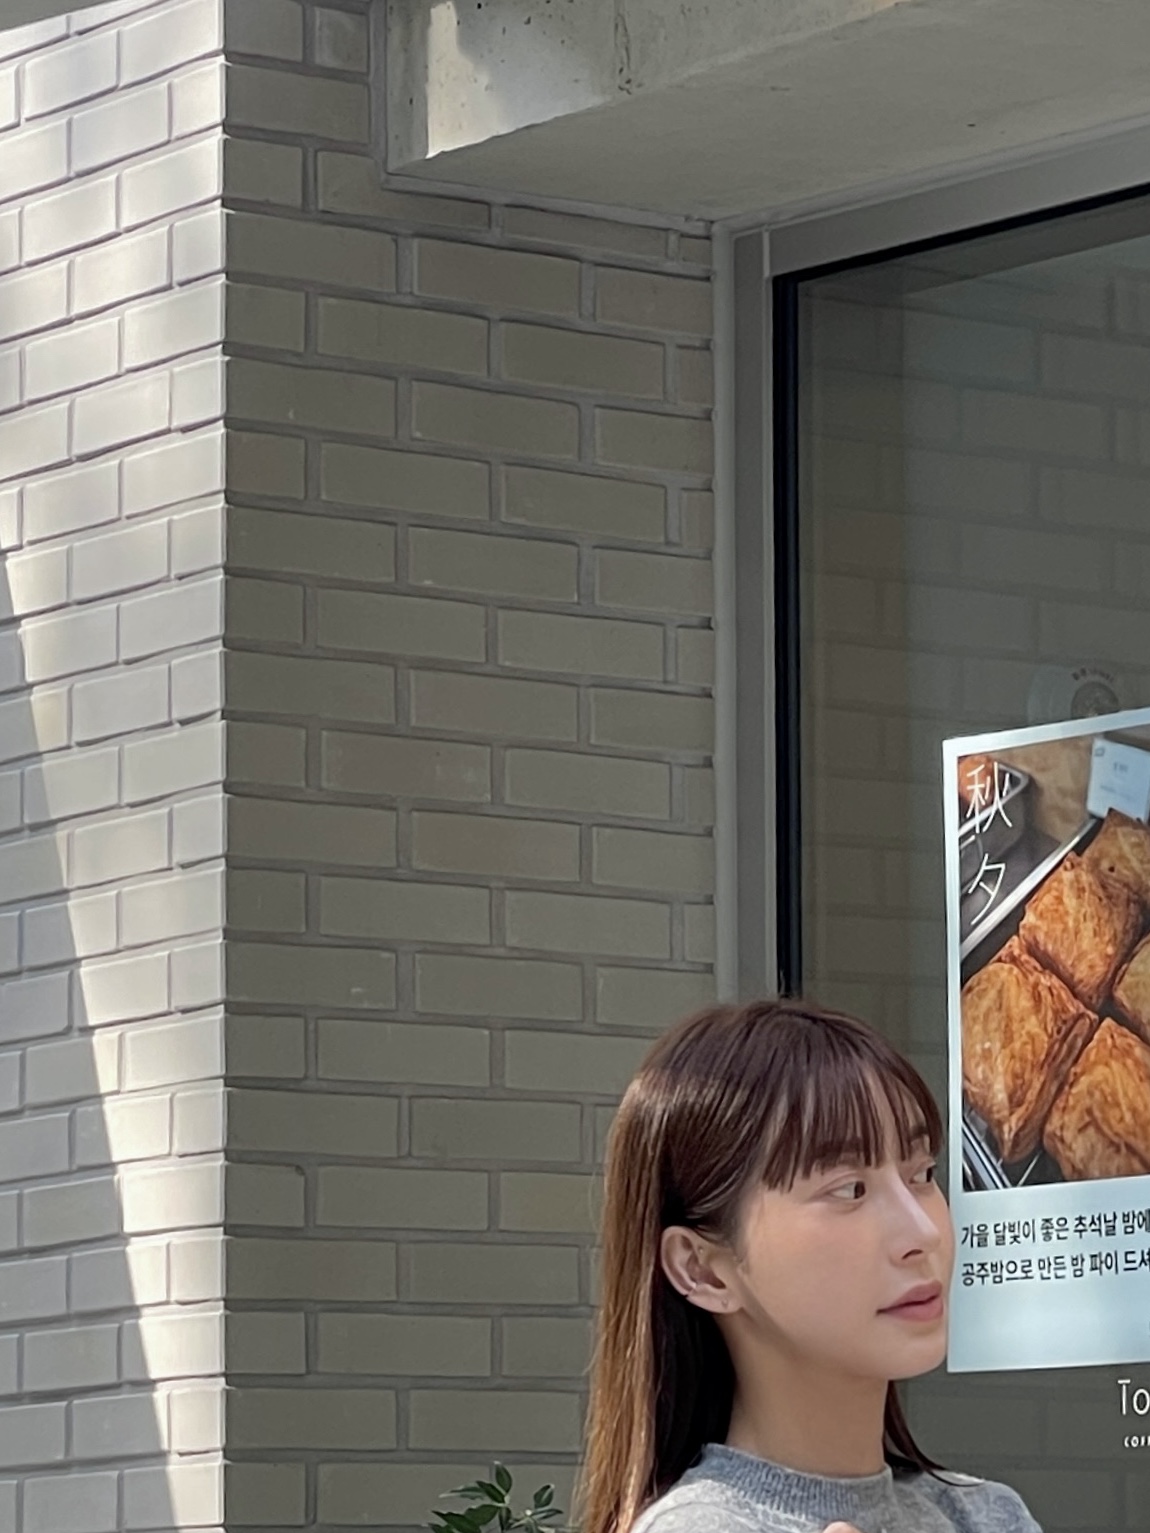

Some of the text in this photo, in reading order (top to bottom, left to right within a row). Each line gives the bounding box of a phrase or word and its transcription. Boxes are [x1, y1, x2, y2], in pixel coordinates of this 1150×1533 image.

[966, 761, 1013, 926] 秋夕
[961, 1208, 1150, 1248] 가을 달빛이 좋은 추석날 밤에
[961, 1258, 1034, 1286] 공주밤으로
[1038, 1255, 1066, 1281] 만든
[1071, 1252, 1085, 1278] 밤
[1089, 1250, 1119, 1276] 파이
